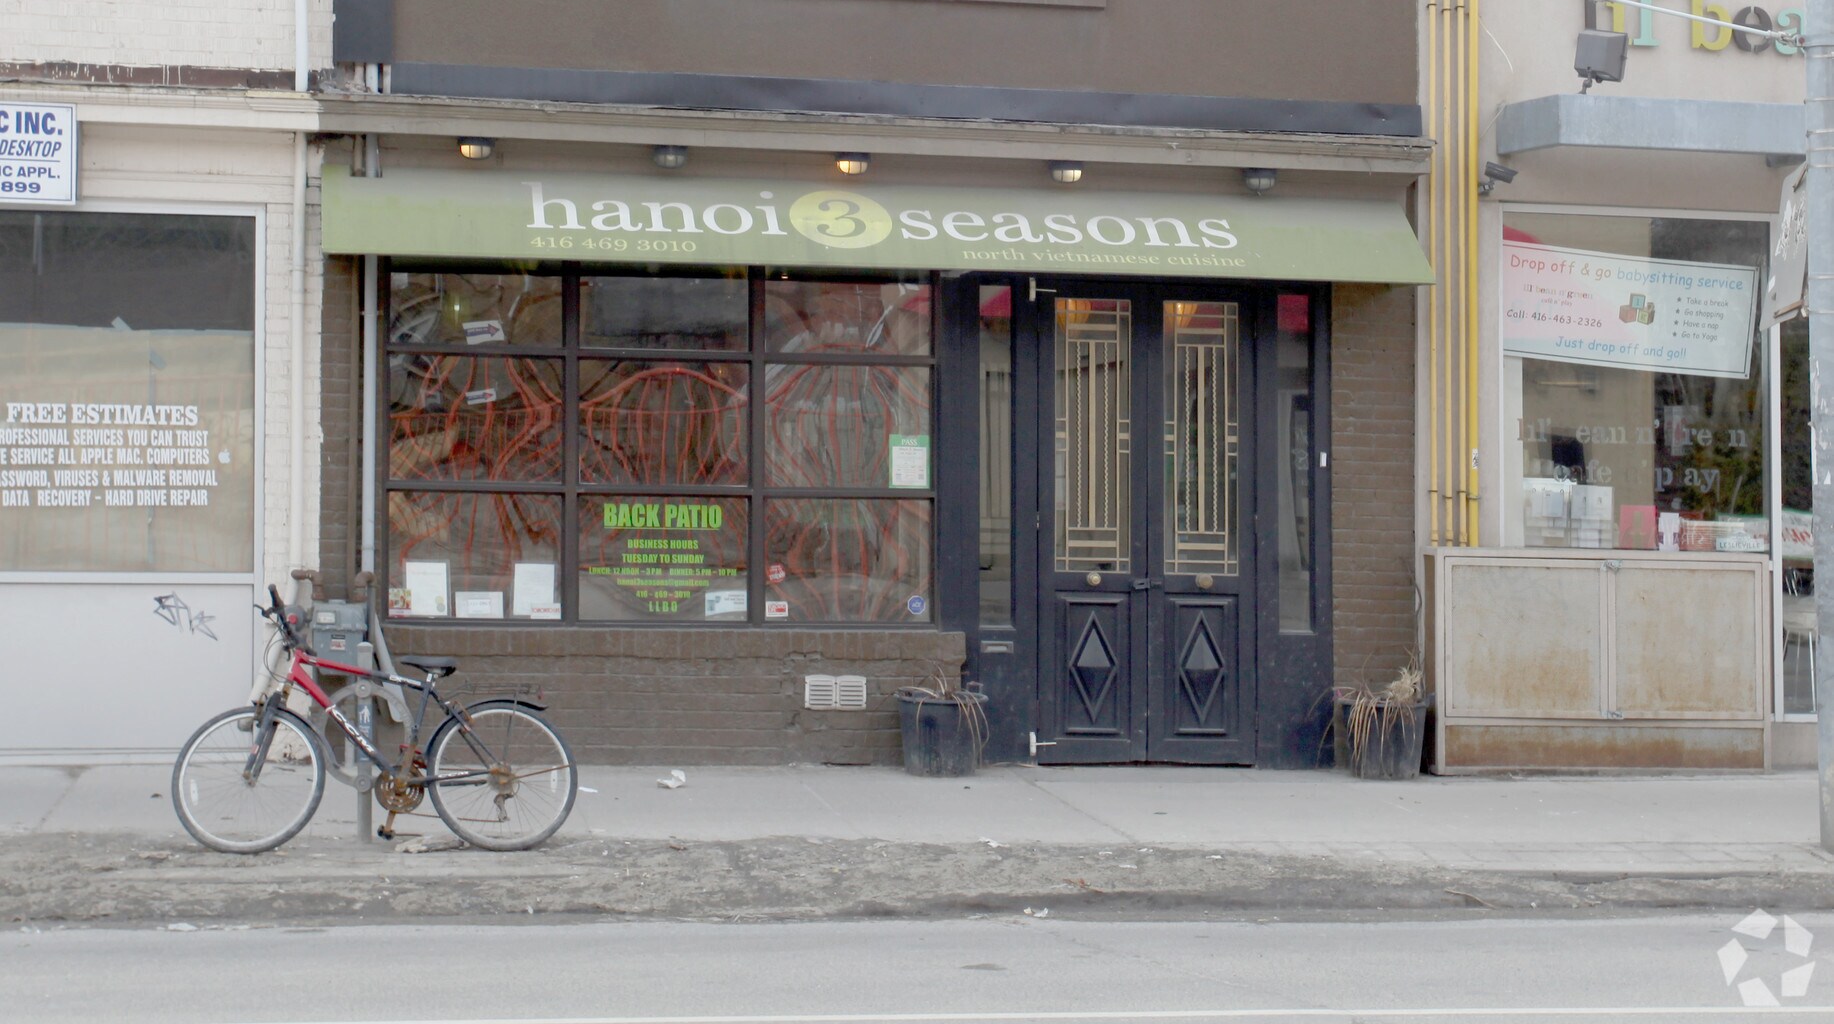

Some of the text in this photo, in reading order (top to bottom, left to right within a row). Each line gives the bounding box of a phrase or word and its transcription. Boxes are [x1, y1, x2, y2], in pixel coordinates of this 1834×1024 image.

[16, 111, 63, 135] INC.
[0, 139, 62, 157] DESKTOP
[17, 166, 60, 179] APPL.
[521, 181, 1239, 248] hanoi 3 seasons
[530, 236, 697, 253] 416 469 3010
[962, 248, 1246, 268] north vietnamese cuisine
[1510, 254, 1744, 290] Drop off & go babysitting service
[1686, 296, 1702, 306] Take
[1506, 309, 1602, 328] Call: 416-463-2326
[1684, 308, 1724, 319] Go shopping
[1683, 320, 1700, 328] Have
[1555, 335, 1585, 351] Just
[1588, 337, 1615, 354] drop
[1620, 343, 1639, 356] off
[1643, 346, 1664, 357] and
[6, 403, 198, 426] FREE ESTIMATES
[73, 428, 123, 446] SERVICES
[127, 429, 148, 446] YOU
[150, 429, 173, 447] CAN
[175, 430, 208, 447] TRUST
[10, 447, 54, 465] SERVICE
[58, 448, 77, 465] ALL
[80, 448, 114, 465] APPLE
[116, 448, 144, 465] MAC.
[146, 448, 210, 465] COMPUTERS
[54, 470, 99, 487] VIRUSES
[102, 470, 110, 487] &
[113, 470, 166, 486] MALWARE
[169, 470, 218, 486] REMOVAL
[1655, 467, 1720, 493] pay
[2, 489, 30, 506] DATA
[37, 489, 92, 506] RECOVERY
[105, 489, 134, 506] HARD
[136, 489, 167, 506] DRIVE
[170, 489, 208, 506] REPAIR
[603, 503, 722, 528] BACK PATIO
[627, 539, 699, 550] BUSINESS HOURS
[622, 553, 704, 564] TUESDAY TO SUNDAY
[651, 567, 663, 576] PM
[701, 568, 712, 576] PM
[726, 568, 737, 576] PM
